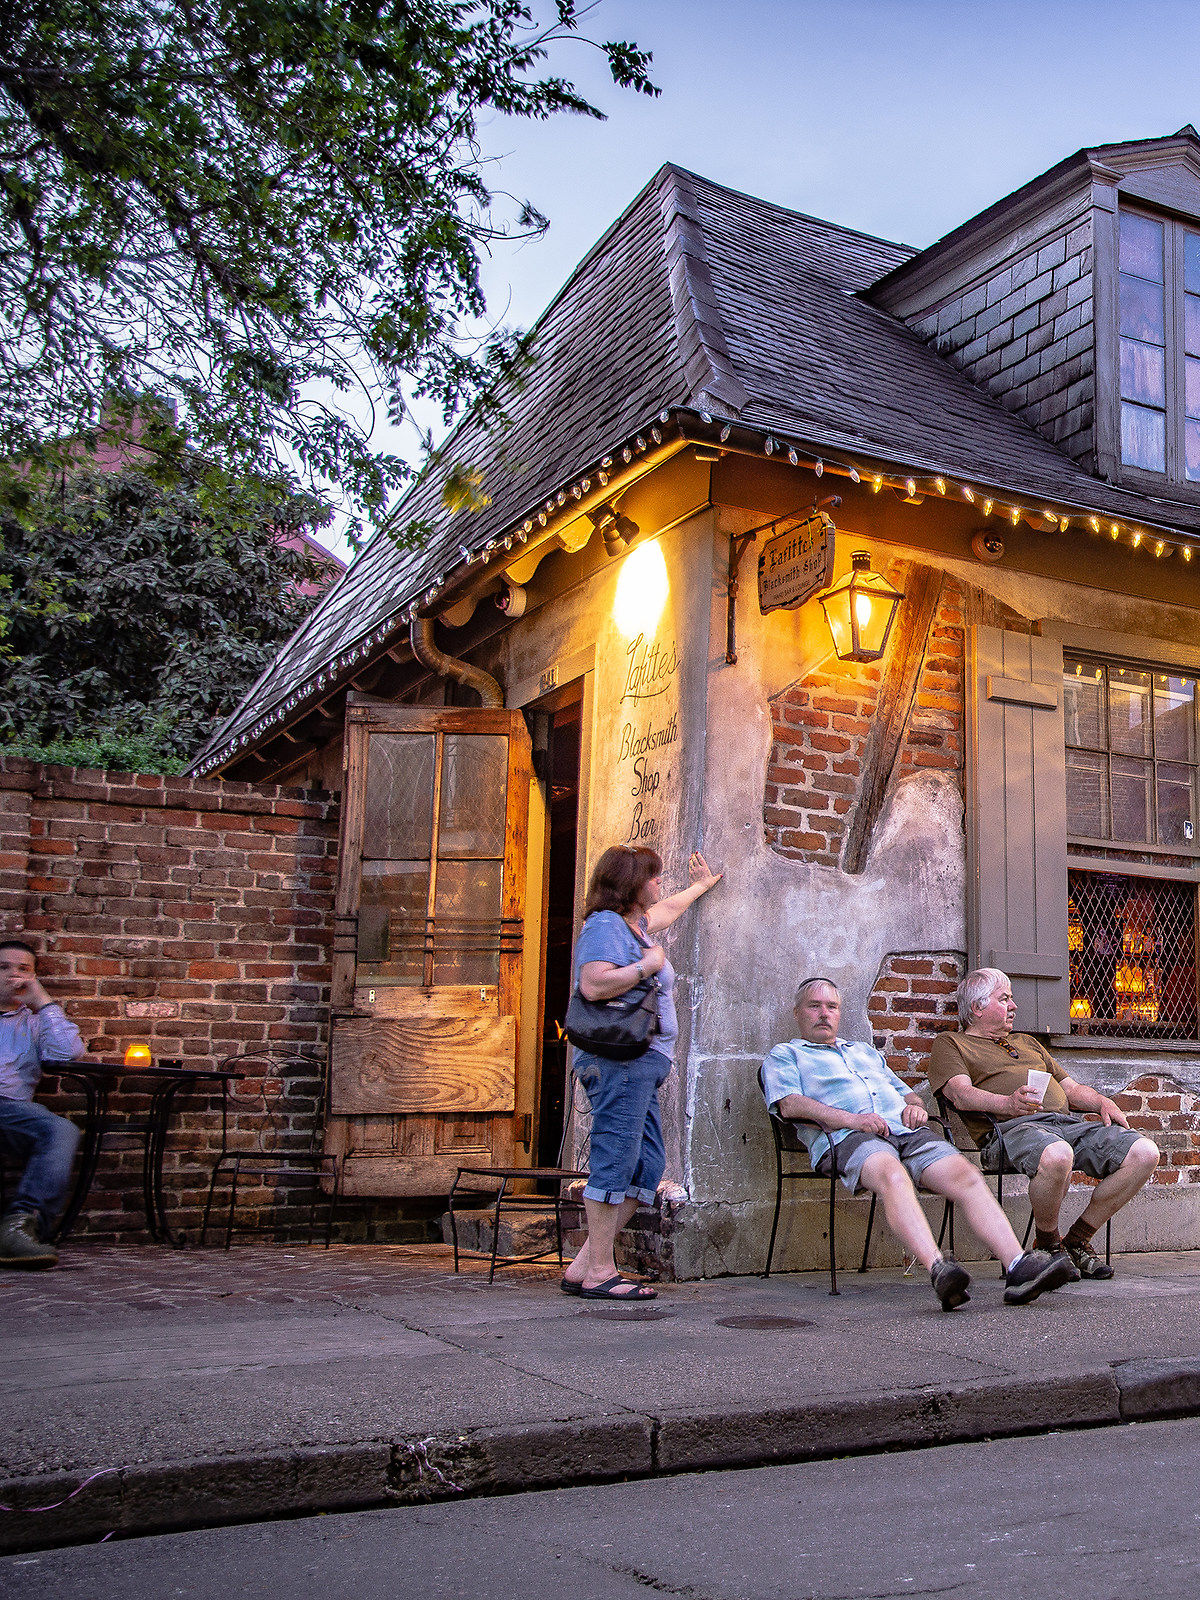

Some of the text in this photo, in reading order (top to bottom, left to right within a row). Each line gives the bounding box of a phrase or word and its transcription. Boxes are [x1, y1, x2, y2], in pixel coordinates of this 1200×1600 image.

[617, 712, 678, 764] Blacksmith
[631, 756, 660, 797] Shop
[627, 801, 657, 843] Bar
